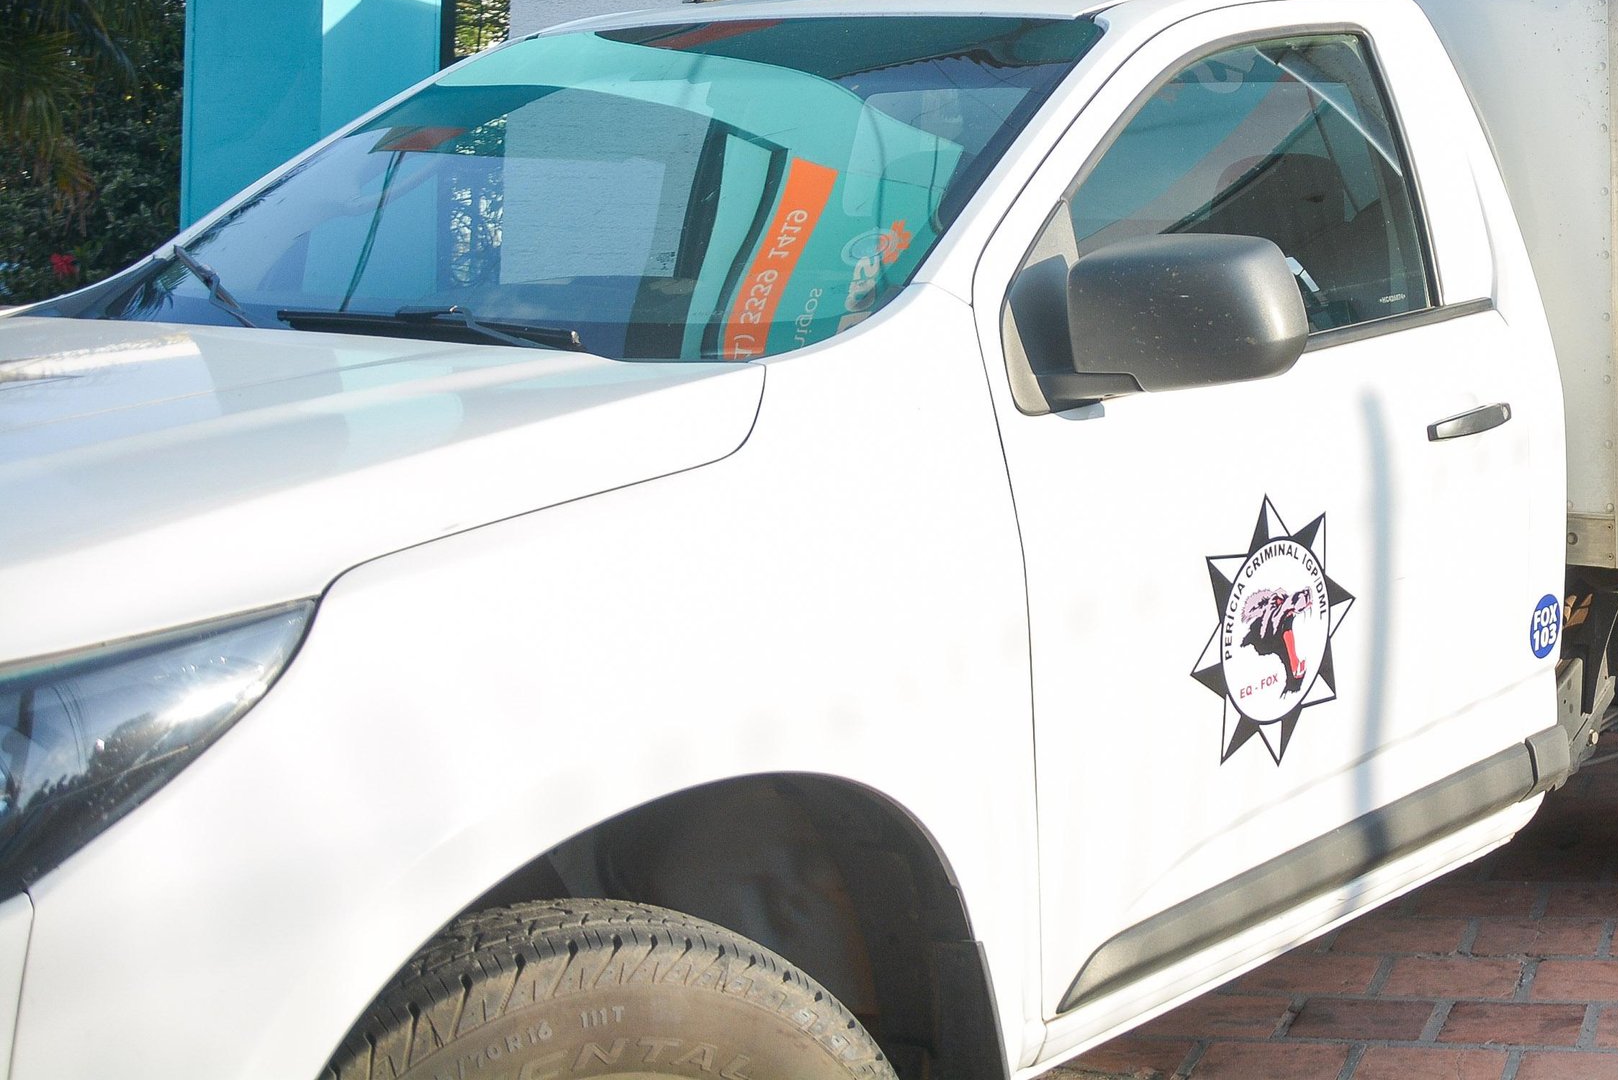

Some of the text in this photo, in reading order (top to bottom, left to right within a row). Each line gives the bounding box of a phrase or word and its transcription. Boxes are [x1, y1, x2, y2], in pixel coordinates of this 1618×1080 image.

[1244, 543, 1300, 579] CRIMINAL
[1533, 602, 1558, 631] FOX
[1533, 623, 1557, 652] 103
[1239, 684, 1253, 699] EQ
[1260, 673, 1280, 691] FOX
